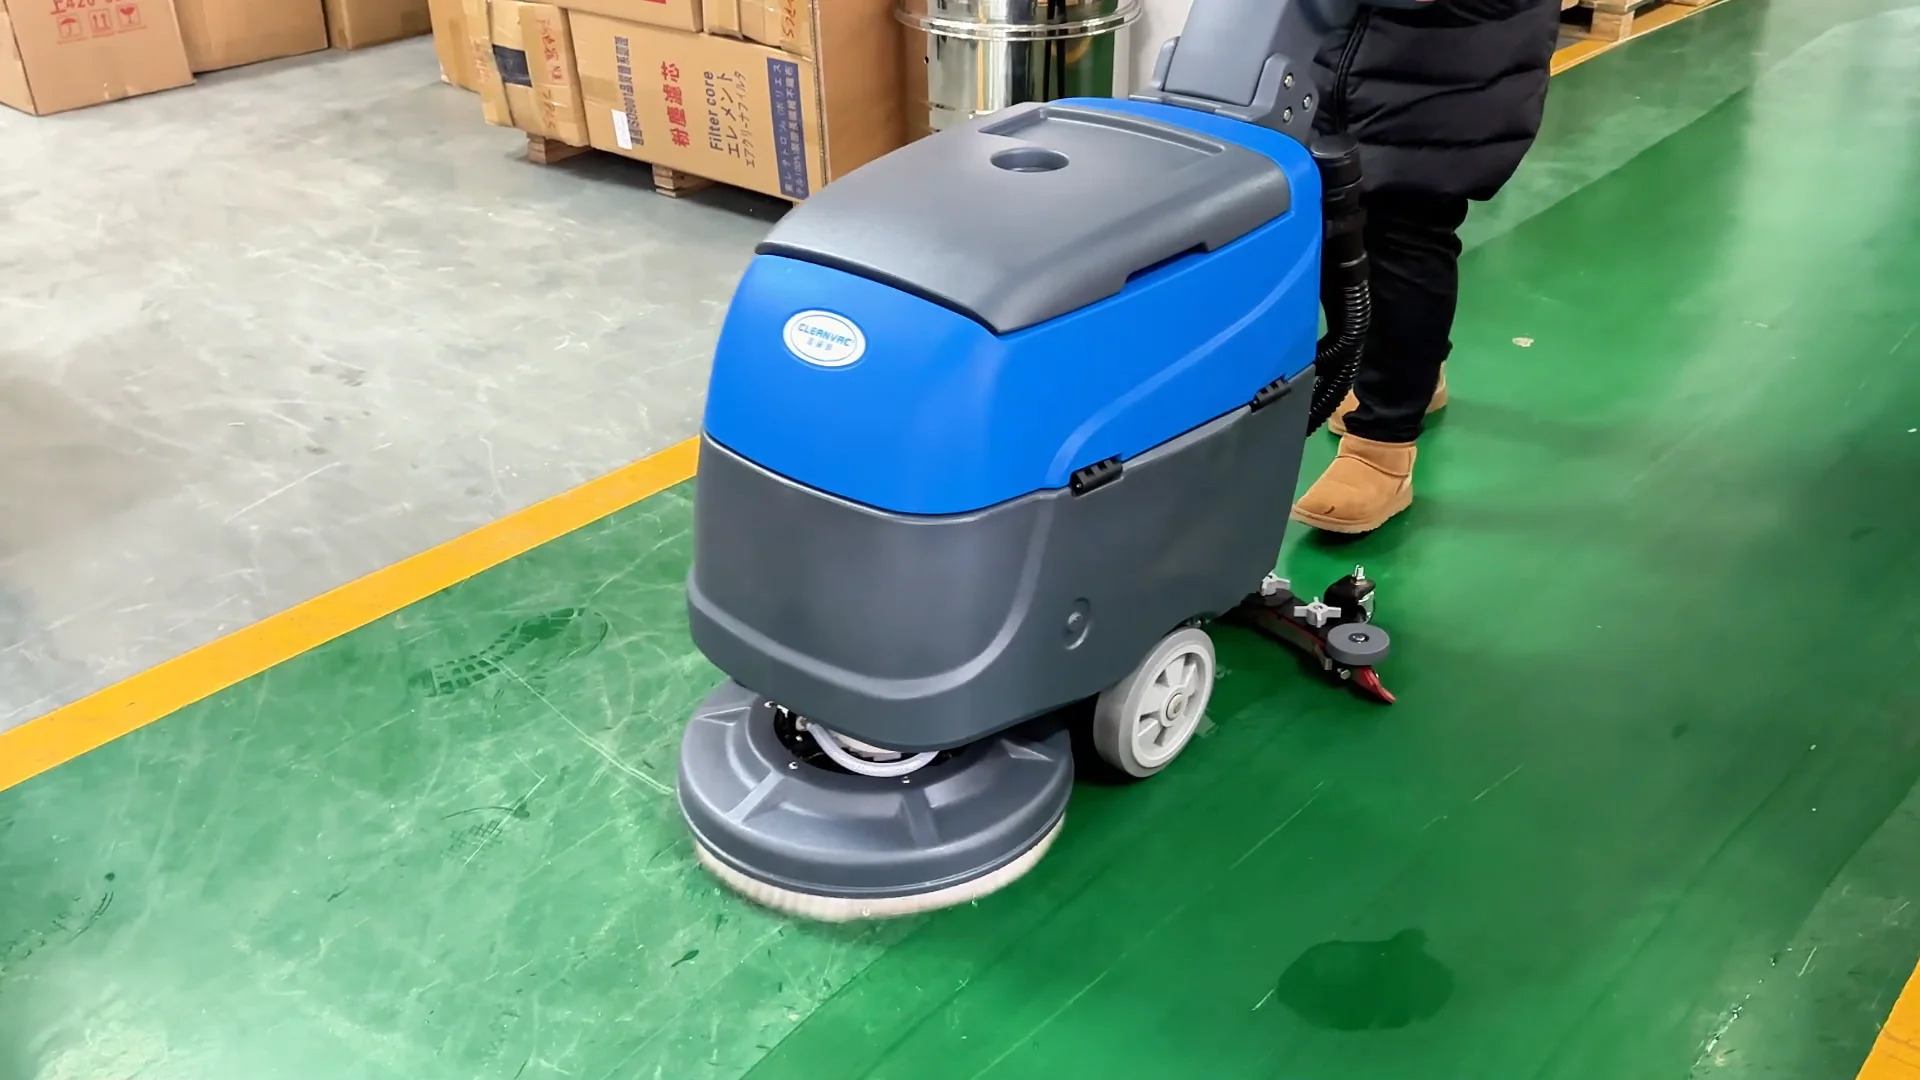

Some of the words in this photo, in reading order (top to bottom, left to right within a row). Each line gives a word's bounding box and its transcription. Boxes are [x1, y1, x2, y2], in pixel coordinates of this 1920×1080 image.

[703, 71, 717, 106] core
[707, 109, 724, 151] Filter
[716, 73, 740, 158] エレメント
[798, 323, 852, 346] CLEANVAC
